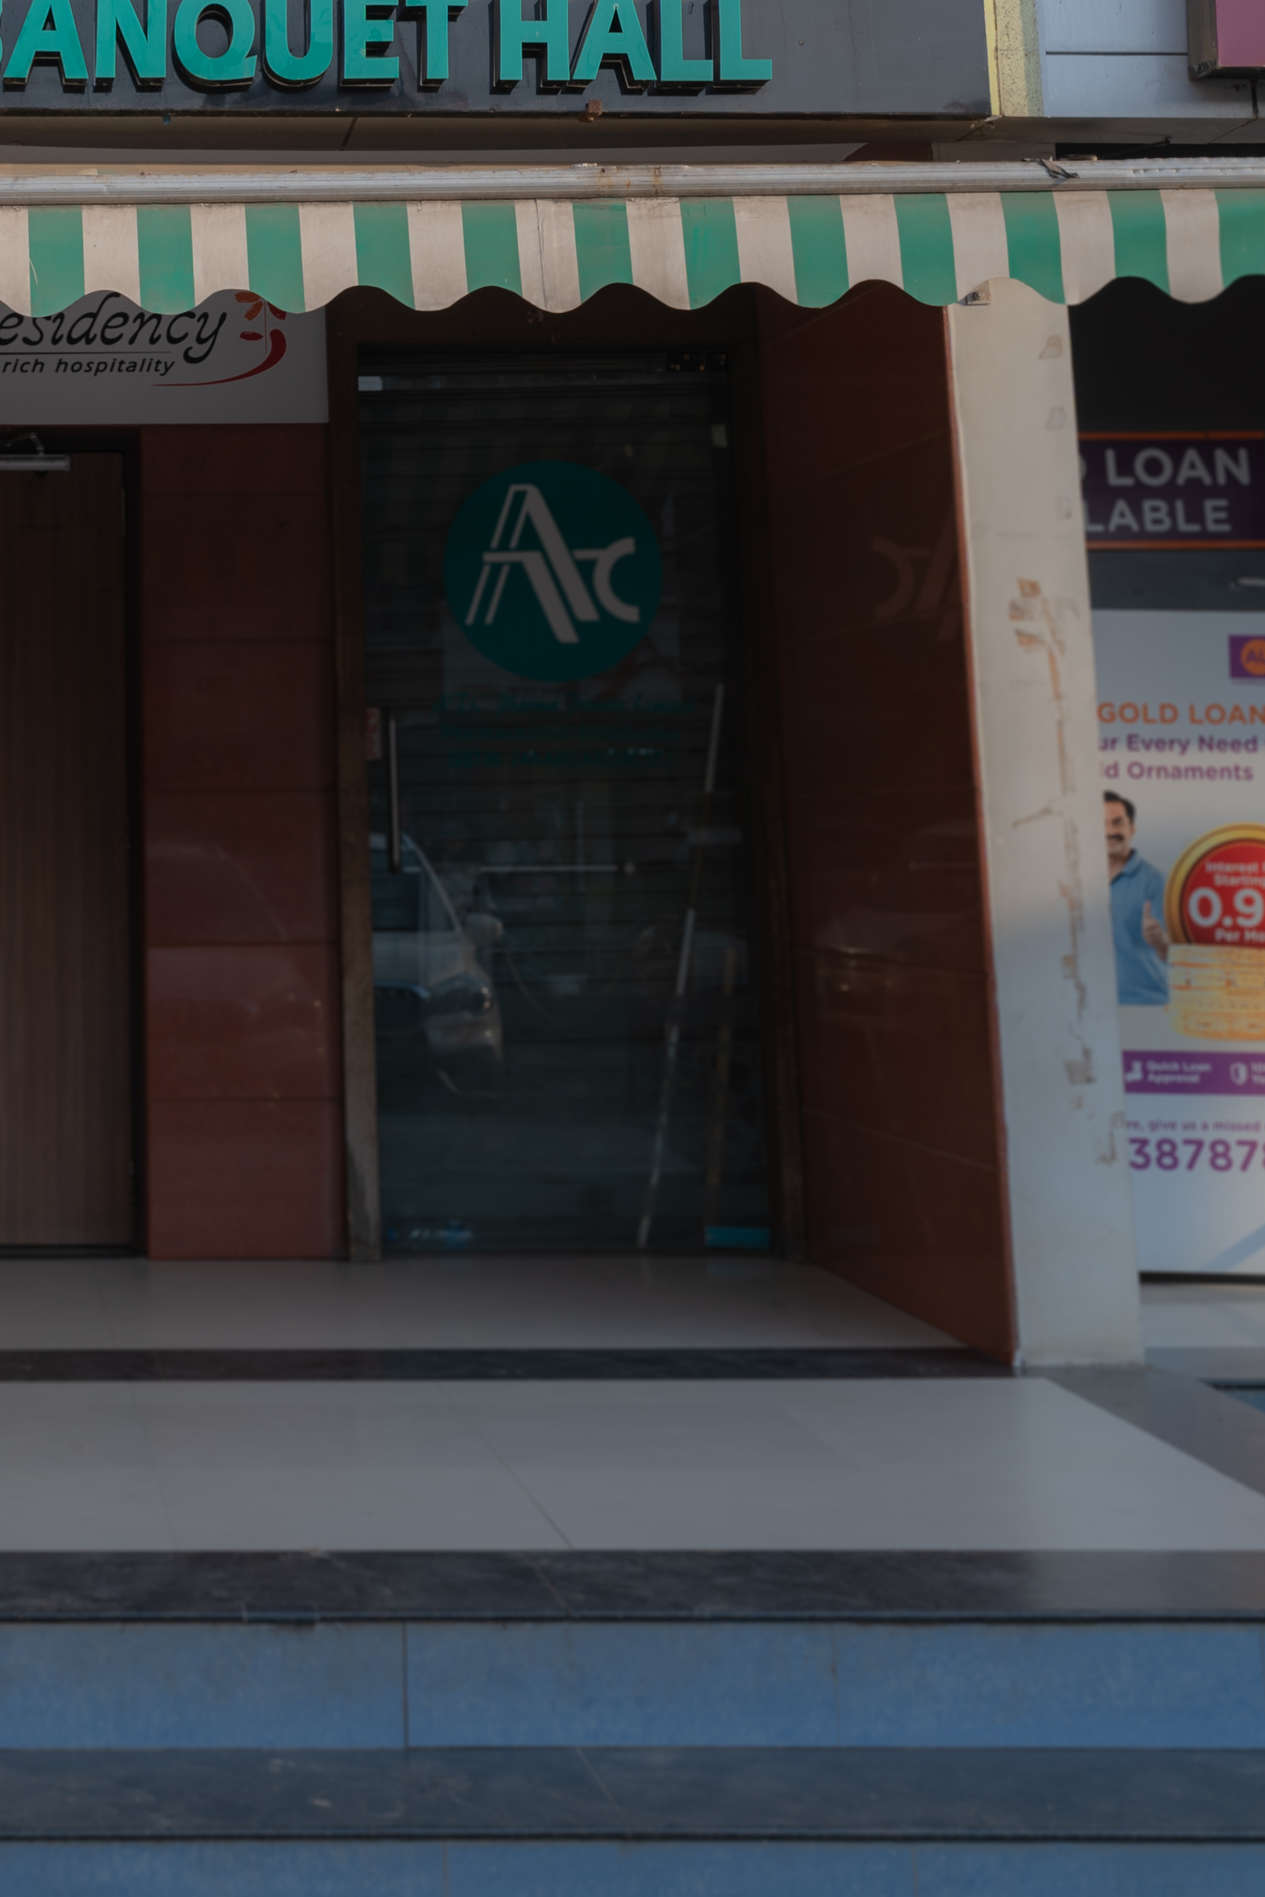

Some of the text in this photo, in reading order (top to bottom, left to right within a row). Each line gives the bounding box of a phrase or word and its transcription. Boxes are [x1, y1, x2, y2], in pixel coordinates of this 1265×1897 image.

[54, 357, 176, 377] hospitality
[1103, 447, 1251, 487] LOAN
[1097, 701, 1179, 725] GOLD
[1126, 734, 1191, 756] Every
[1198, 735, 1259, 754] Need
[1127, 760, 1254, 782] Ornaments
[1188, 887, 1264, 927] 0.9
[1127, 1136, 1265, 1173] 38787
